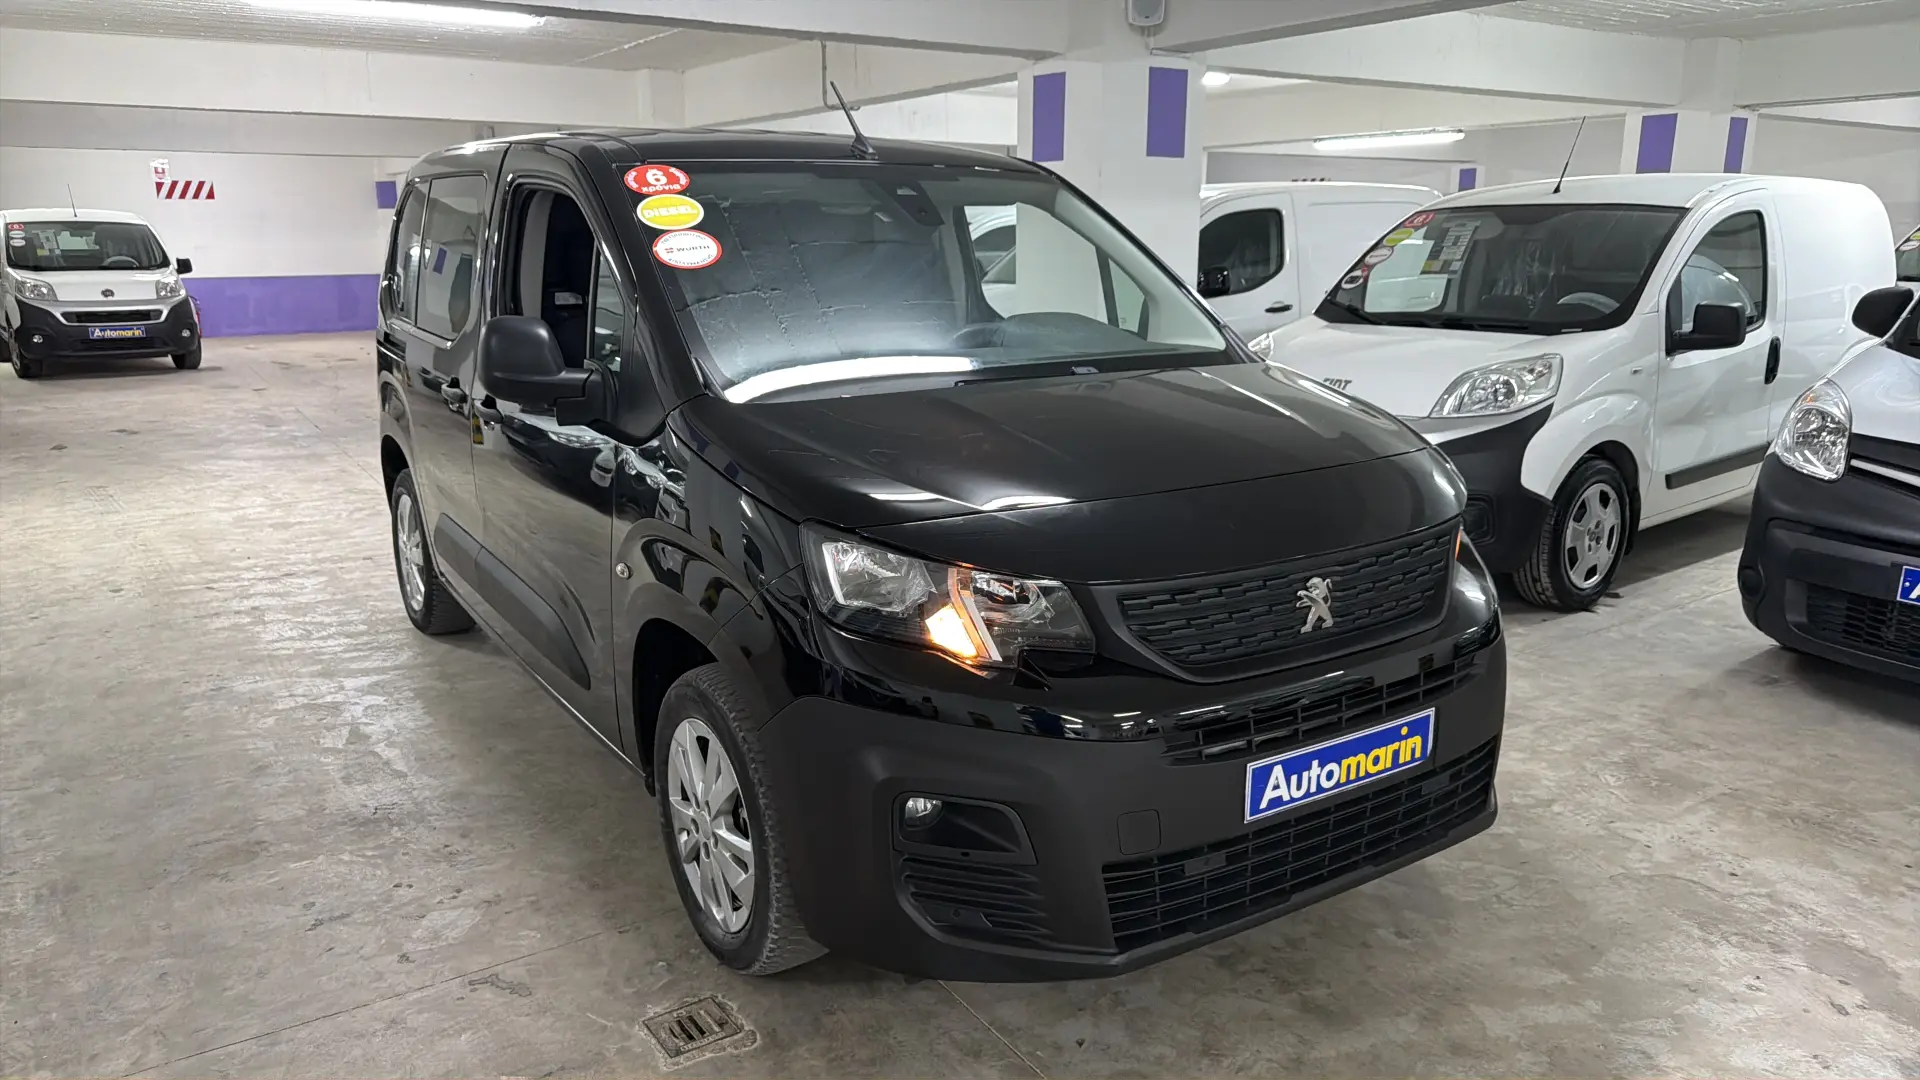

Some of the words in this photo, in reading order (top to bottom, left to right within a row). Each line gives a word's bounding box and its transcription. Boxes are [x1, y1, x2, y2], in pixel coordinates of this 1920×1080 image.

[646, 169, 668, 186] 6
[642, 205, 698, 219] DIESEL
[93, 326, 143, 338] Automarin
[1259, 726, 1422, 810] Automarin
